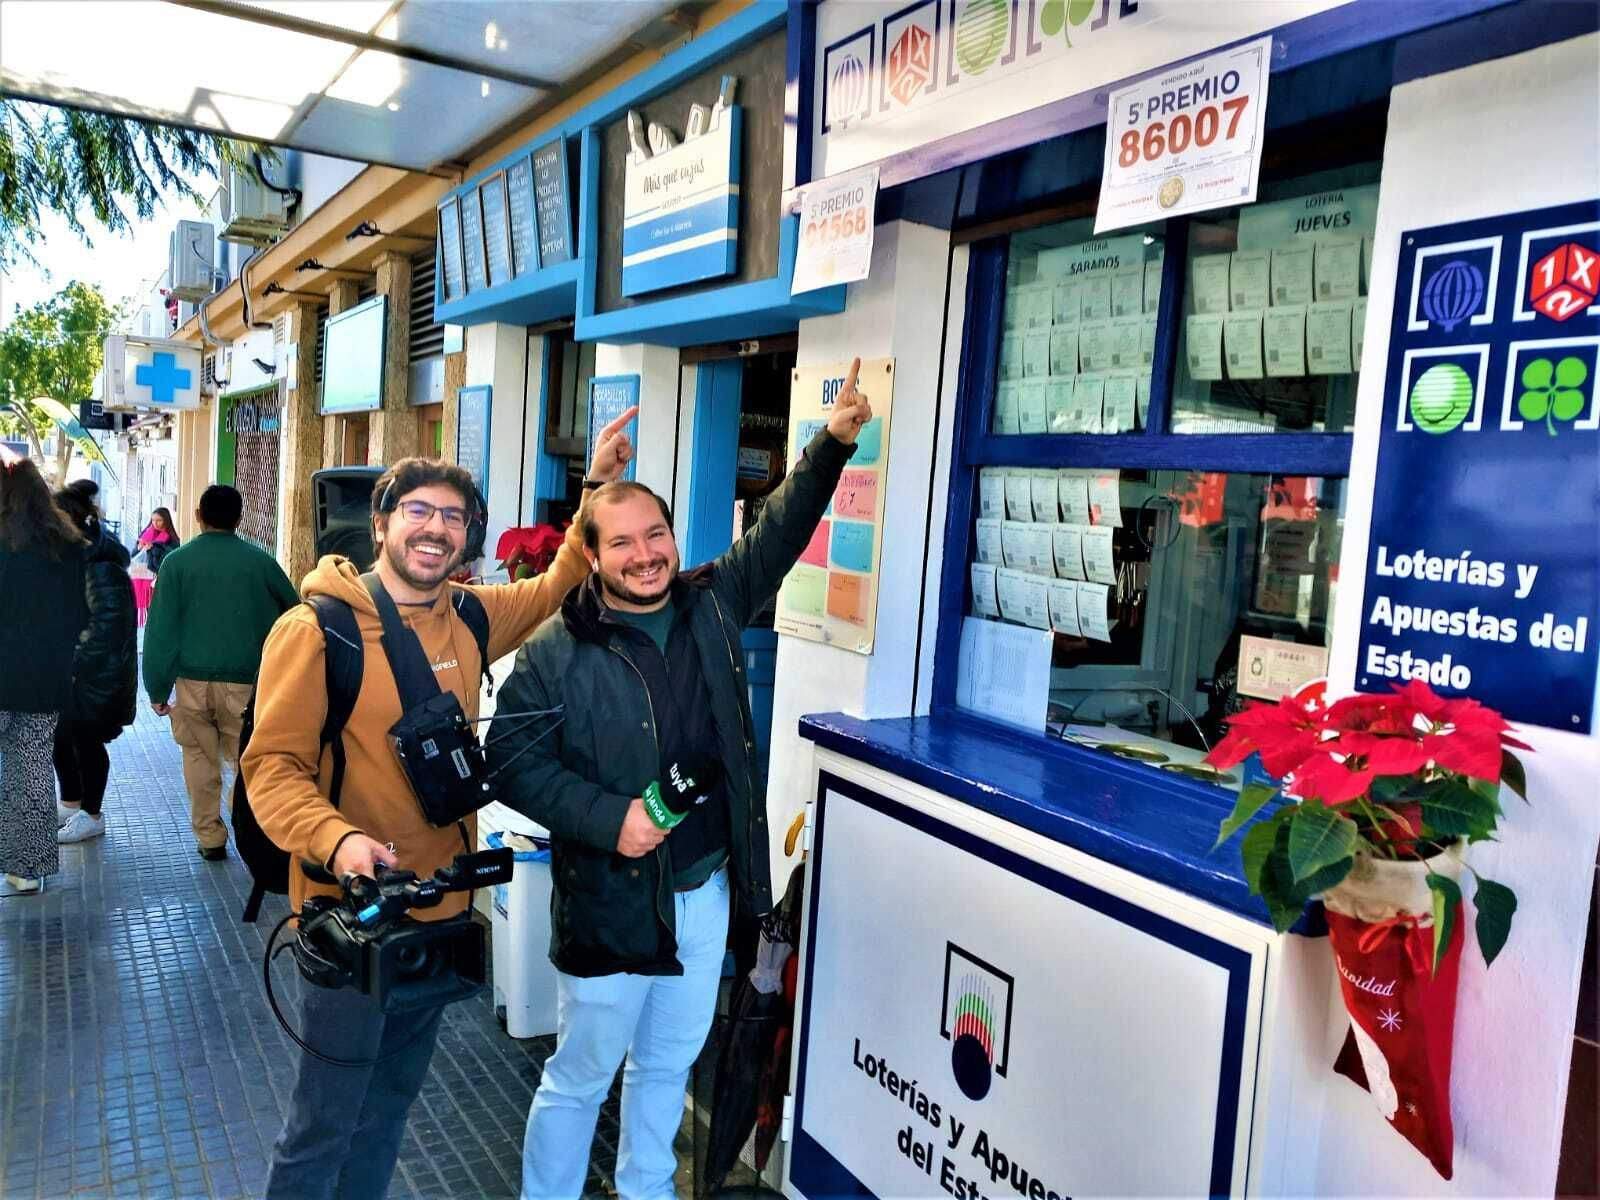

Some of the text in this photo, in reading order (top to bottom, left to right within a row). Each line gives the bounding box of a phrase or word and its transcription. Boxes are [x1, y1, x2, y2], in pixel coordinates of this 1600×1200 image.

[1147, 70, 1240, 119] PREMIO
[1118, 95, 1250, 169] 86007
[663, 168, 678, 192] que
[680, 158, 704, 185] cajas
[820, 187, 864, 217] PREMIO
[1295, 210, 1351, 232] JUEVES
[1376, 546, 1539, 599] Loterías y
[1370, 596, 1588, 653] Apuestas del
[1366, 645, 1471, 690] Estado
[853, 1037, 1072, 1200] Loterías y Apue
[897, 1126, 989, 1200] del Est
